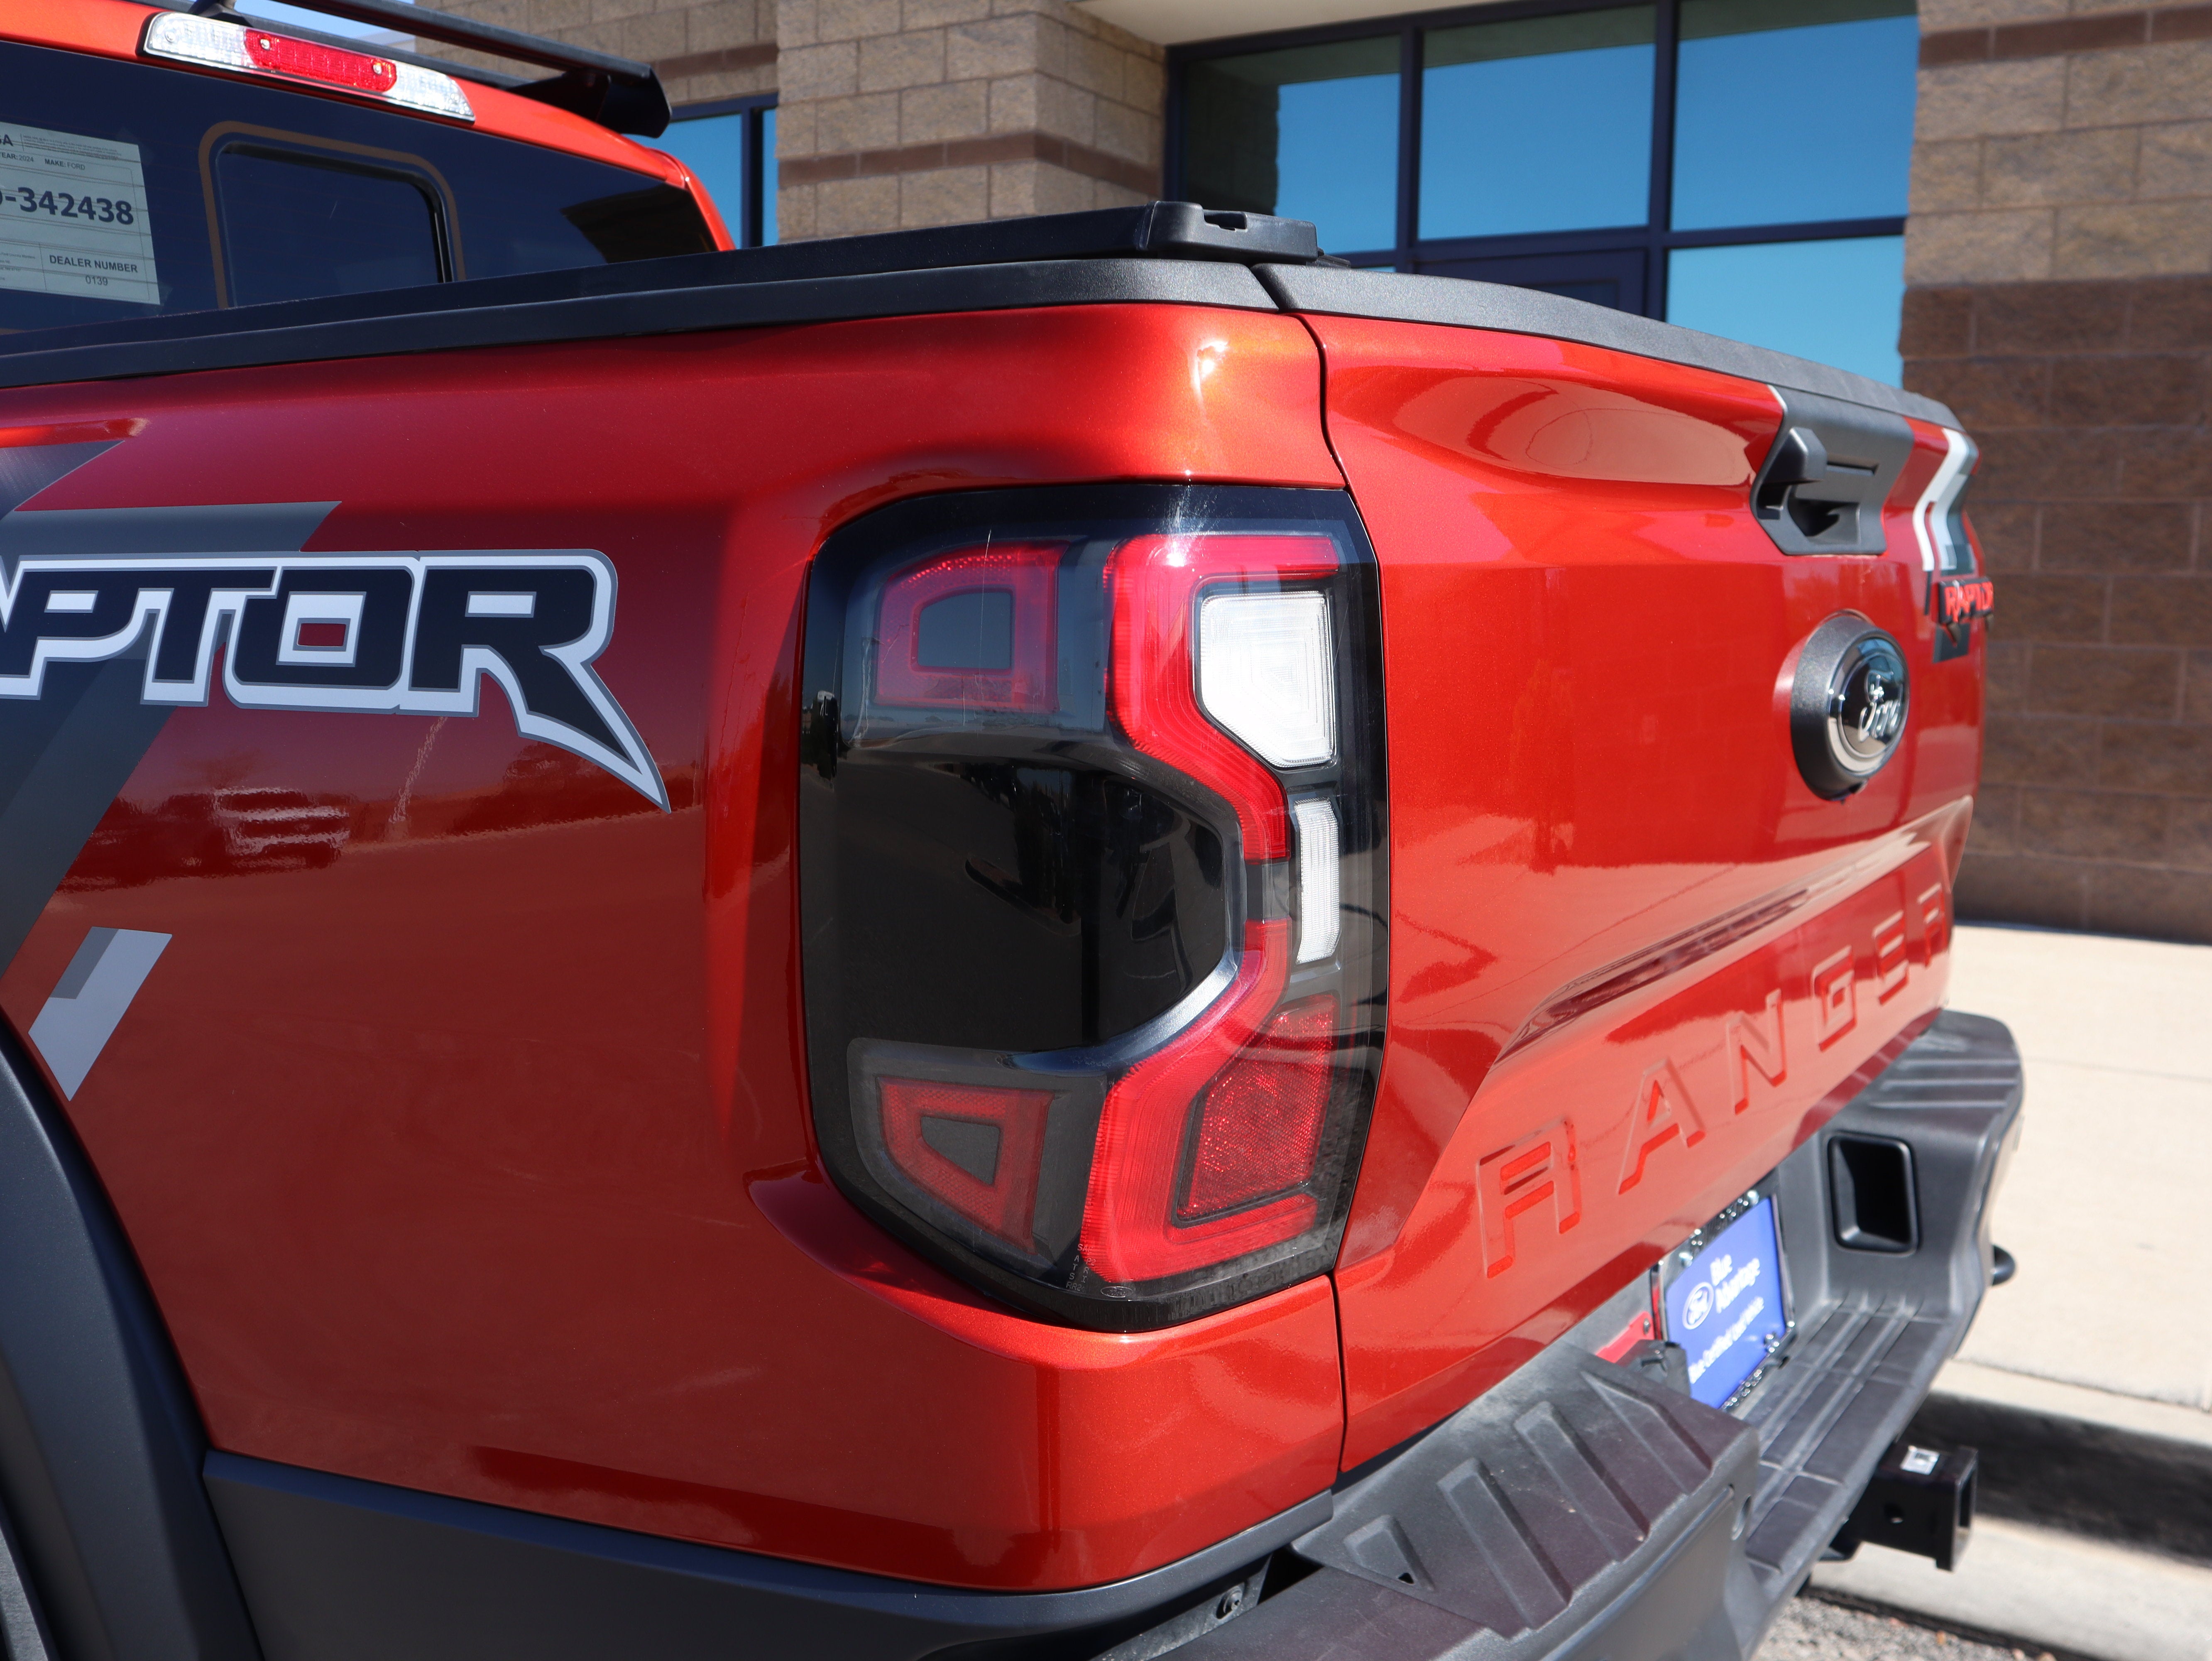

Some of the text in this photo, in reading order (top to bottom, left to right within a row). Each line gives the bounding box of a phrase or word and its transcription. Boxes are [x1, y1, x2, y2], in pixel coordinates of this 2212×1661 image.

[0, 134, 14, 147] A
[0, 152, 18, 160] EAR:
[44, 159, 66, 168] MAKE:
[67, 162, 86, 171] FORD
[0, 187, 134, 225] -342438
[49, 254, 92, 268] DEALER
[94, 260, 138, 273] NUMBER
[85, 275, 108, 286] 0139
[0, 549, 671, 814] PTOR
[1475, 882, 1948, 1279] RANGER
